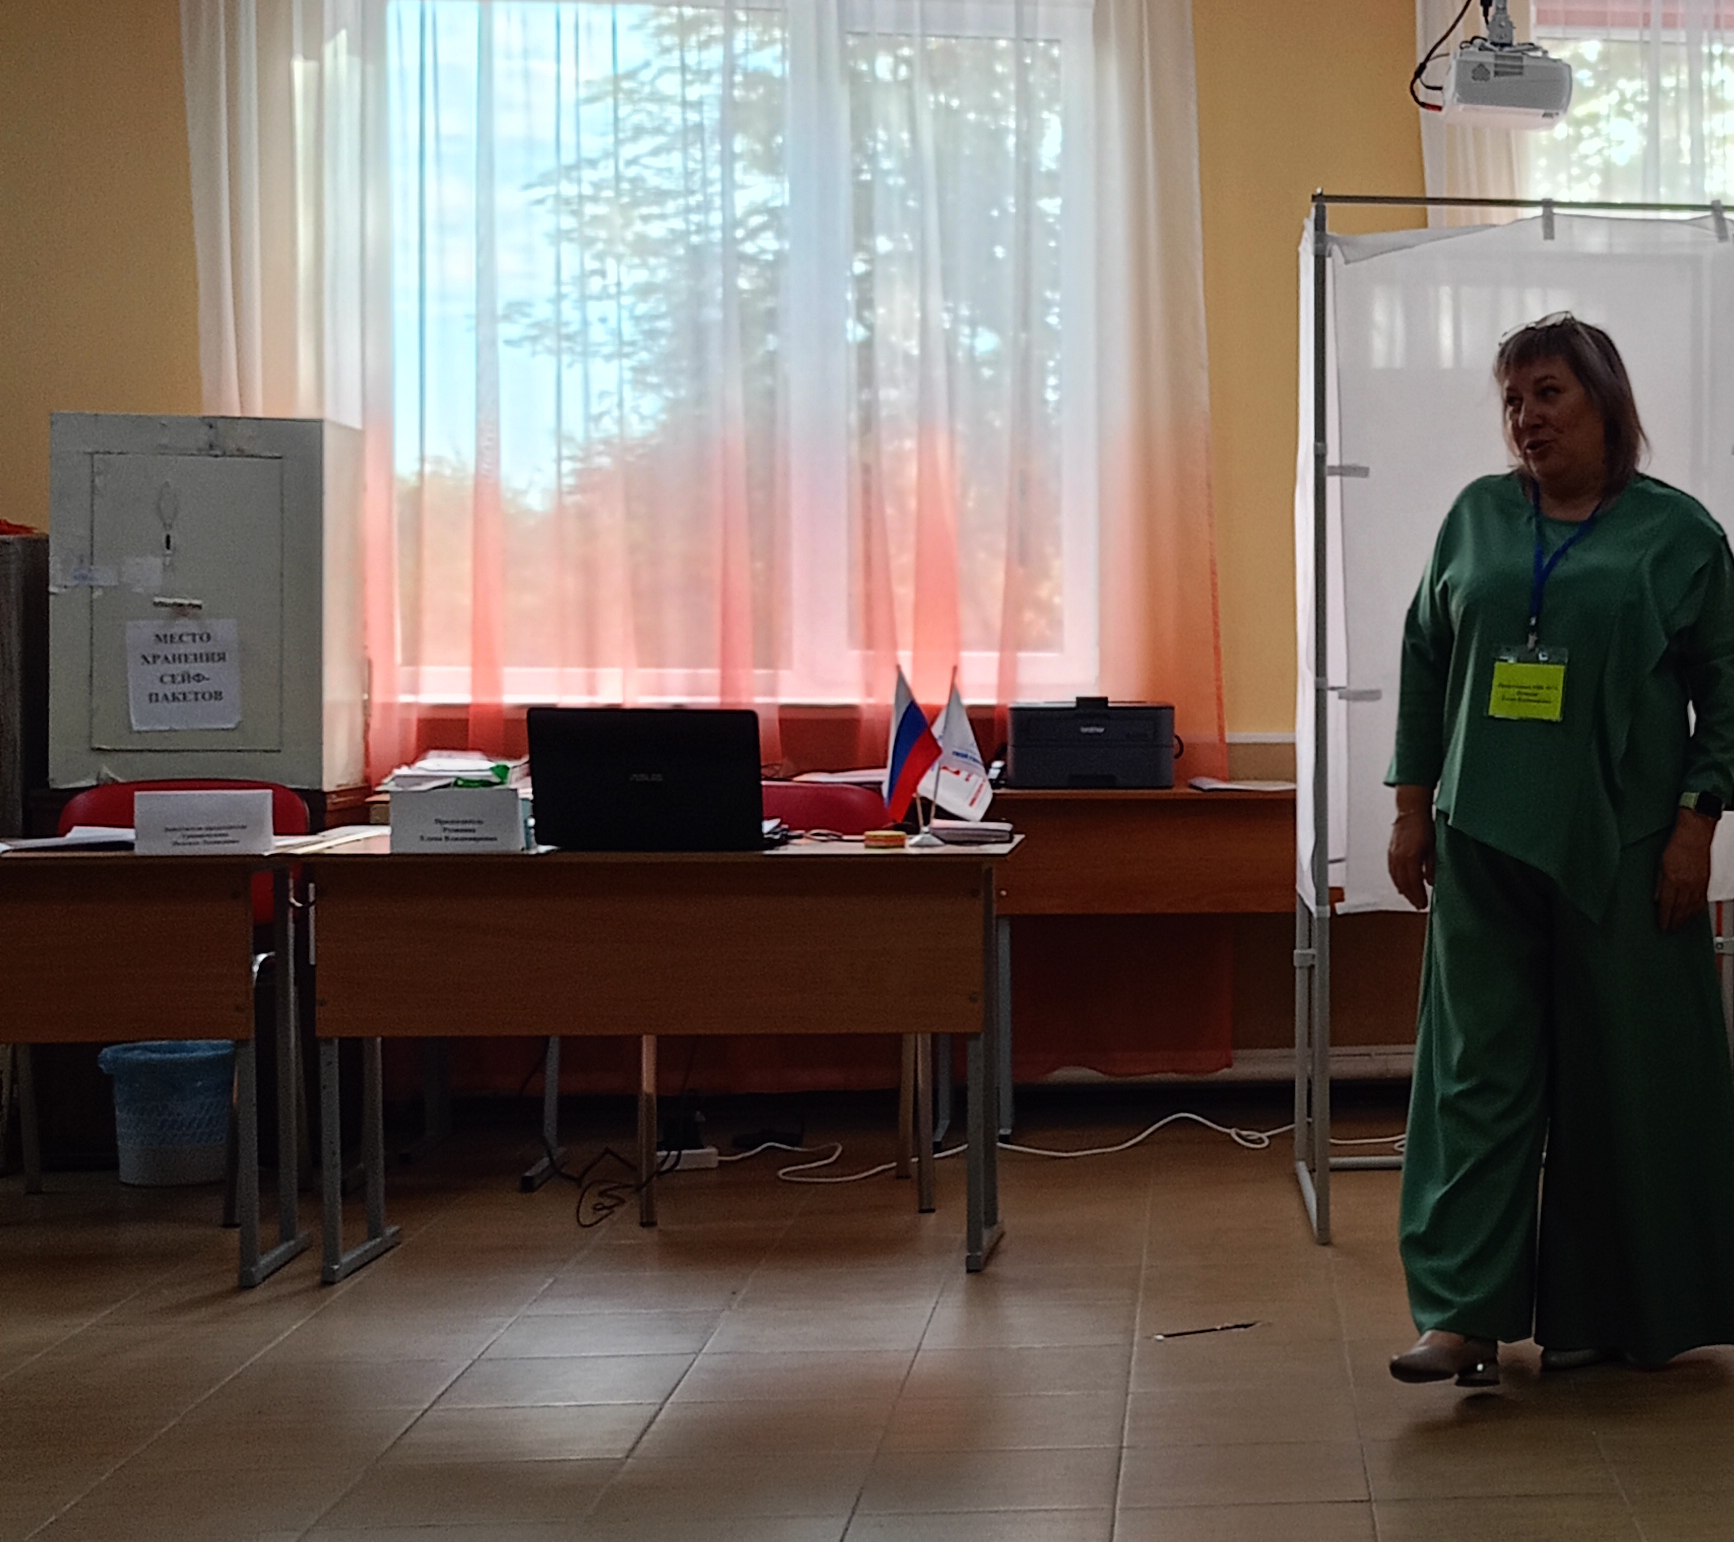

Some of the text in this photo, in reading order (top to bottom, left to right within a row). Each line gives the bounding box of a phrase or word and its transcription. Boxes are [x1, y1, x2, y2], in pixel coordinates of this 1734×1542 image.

[154, 631, 212, 645] МЕСТО
[140, 651, 227, 666] ХРАНЕНИЯ
[159, 671, 211, 685] СЕЙФ-
[148, 690, 224, 704] ПАКЕТОВ
